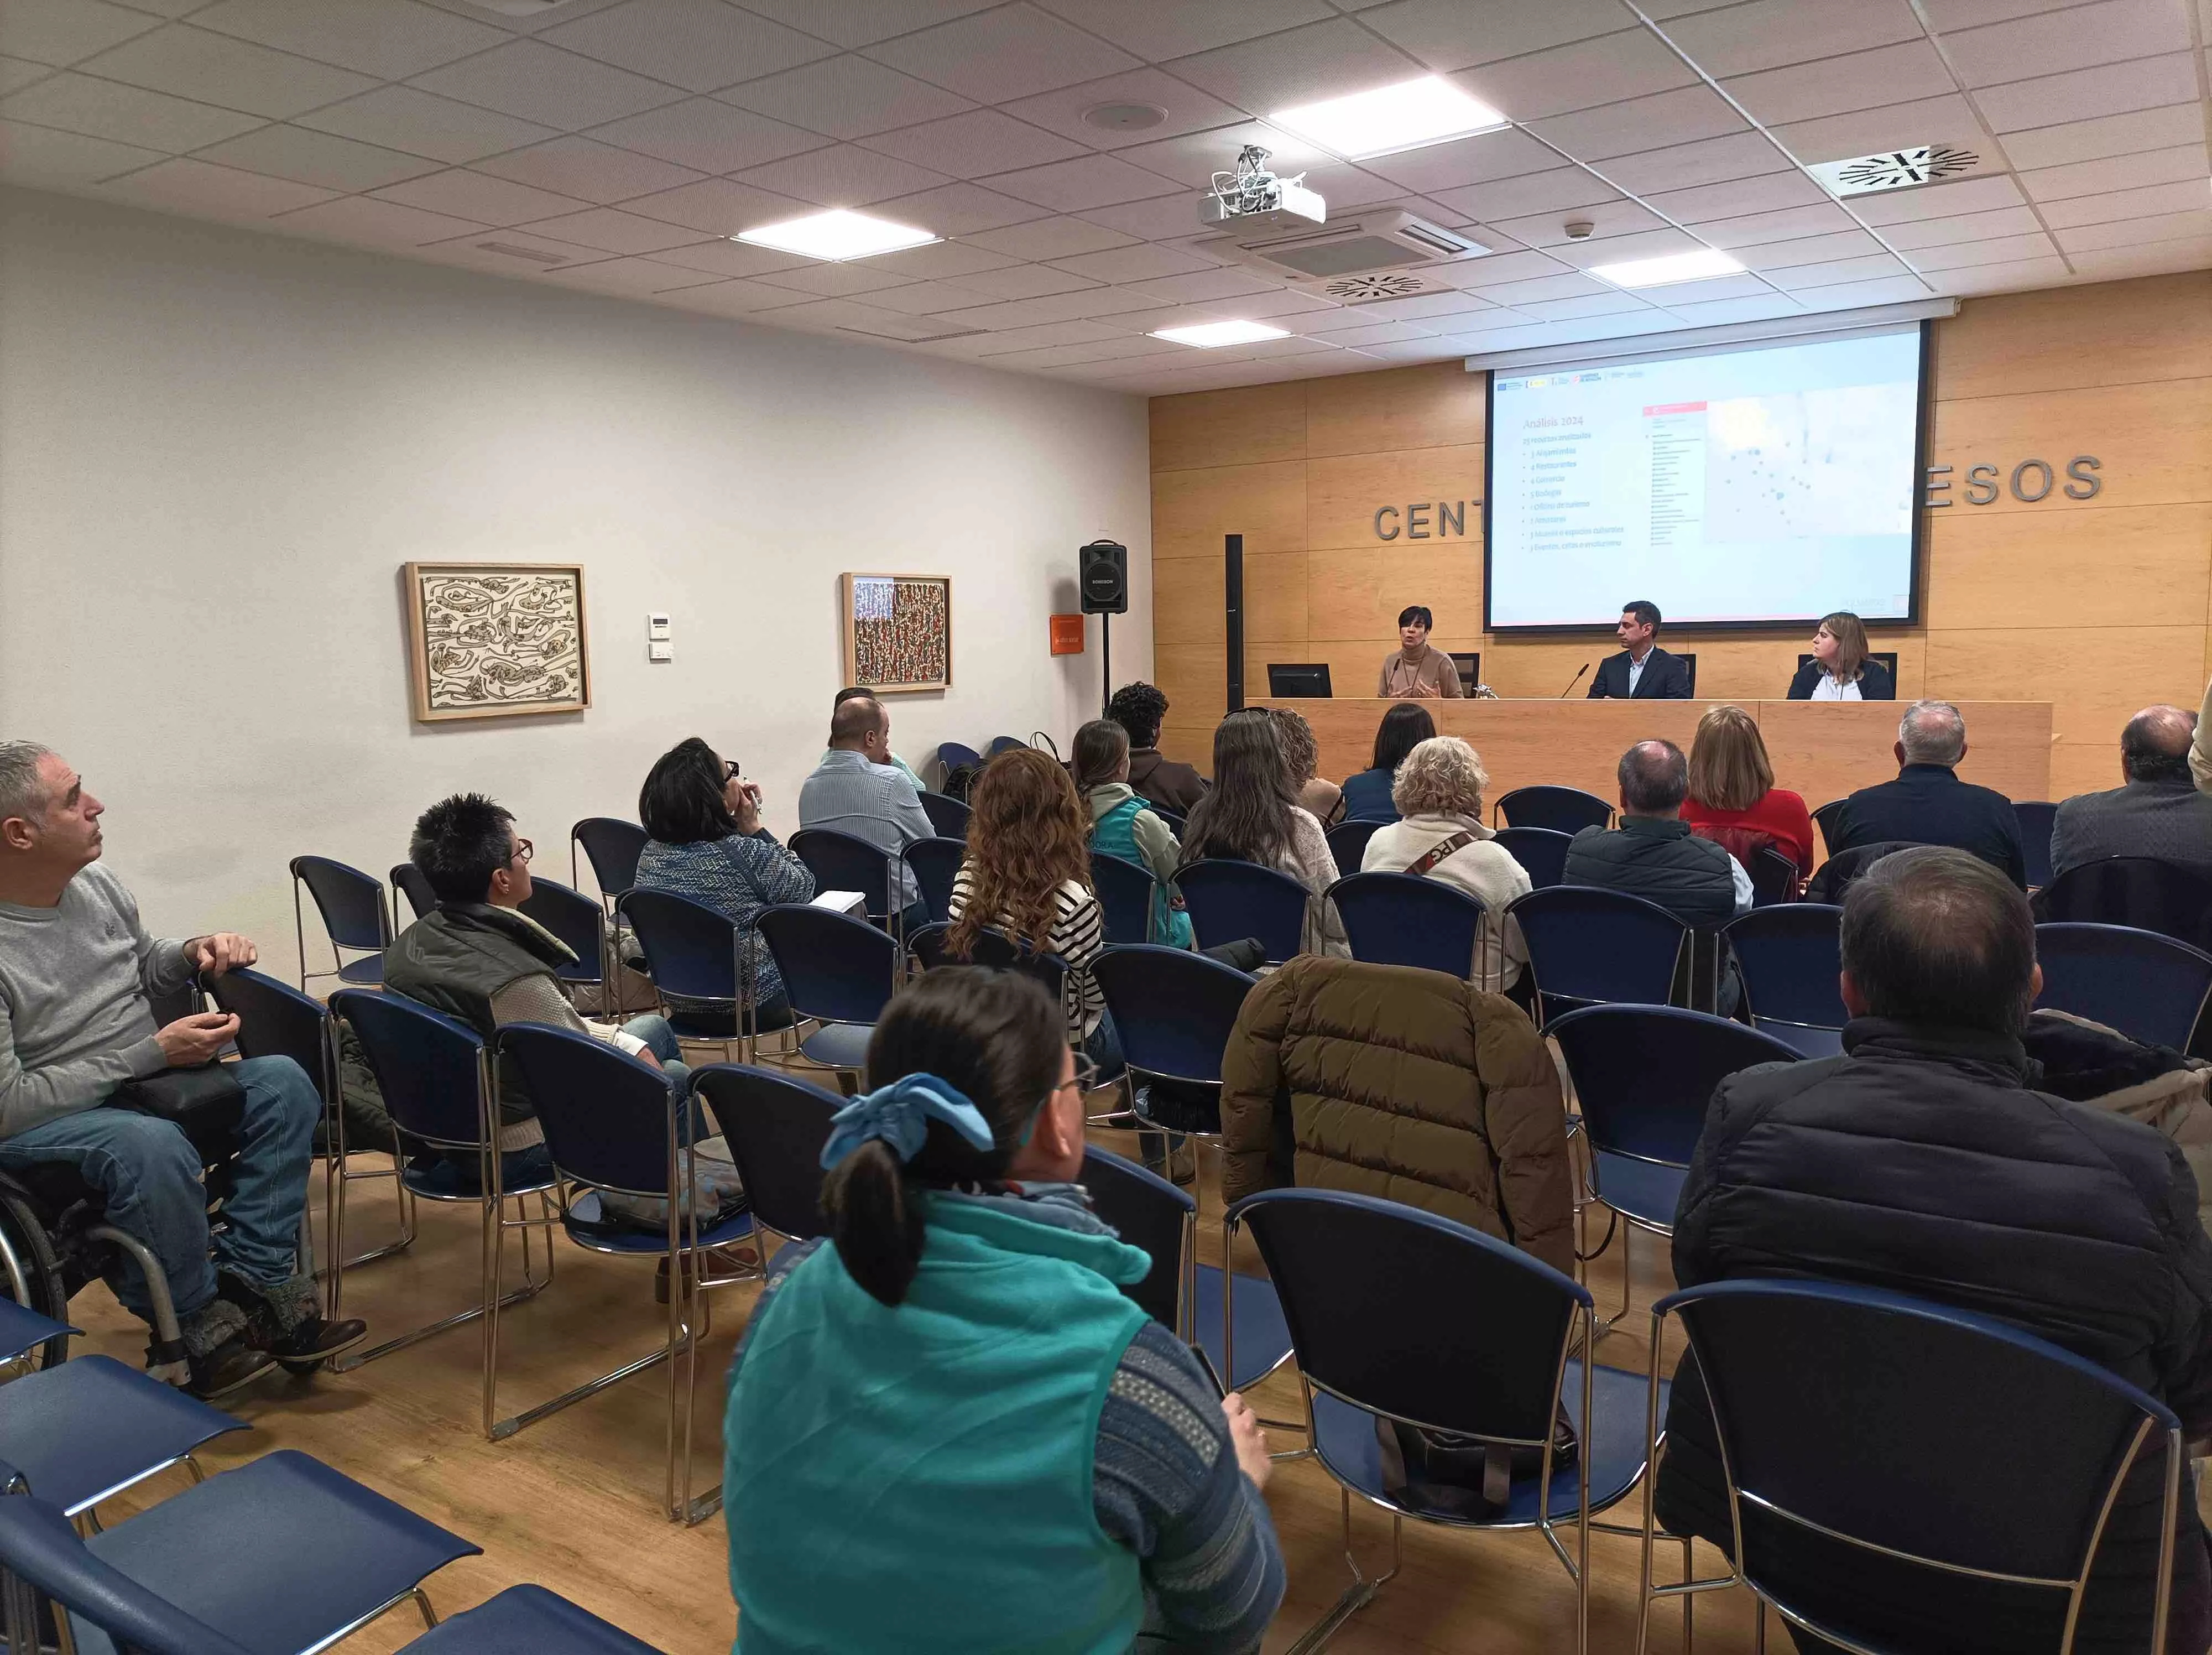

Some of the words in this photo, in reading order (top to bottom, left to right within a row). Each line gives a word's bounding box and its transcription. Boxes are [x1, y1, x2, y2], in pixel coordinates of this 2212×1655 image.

[1523, 416, 1559, 429] Análisis
[1561, 415, 1584, 426] 2024
[1536, 461, 1577, 470] Restaurantes
[1374, 499, 1484, 541] CENT
